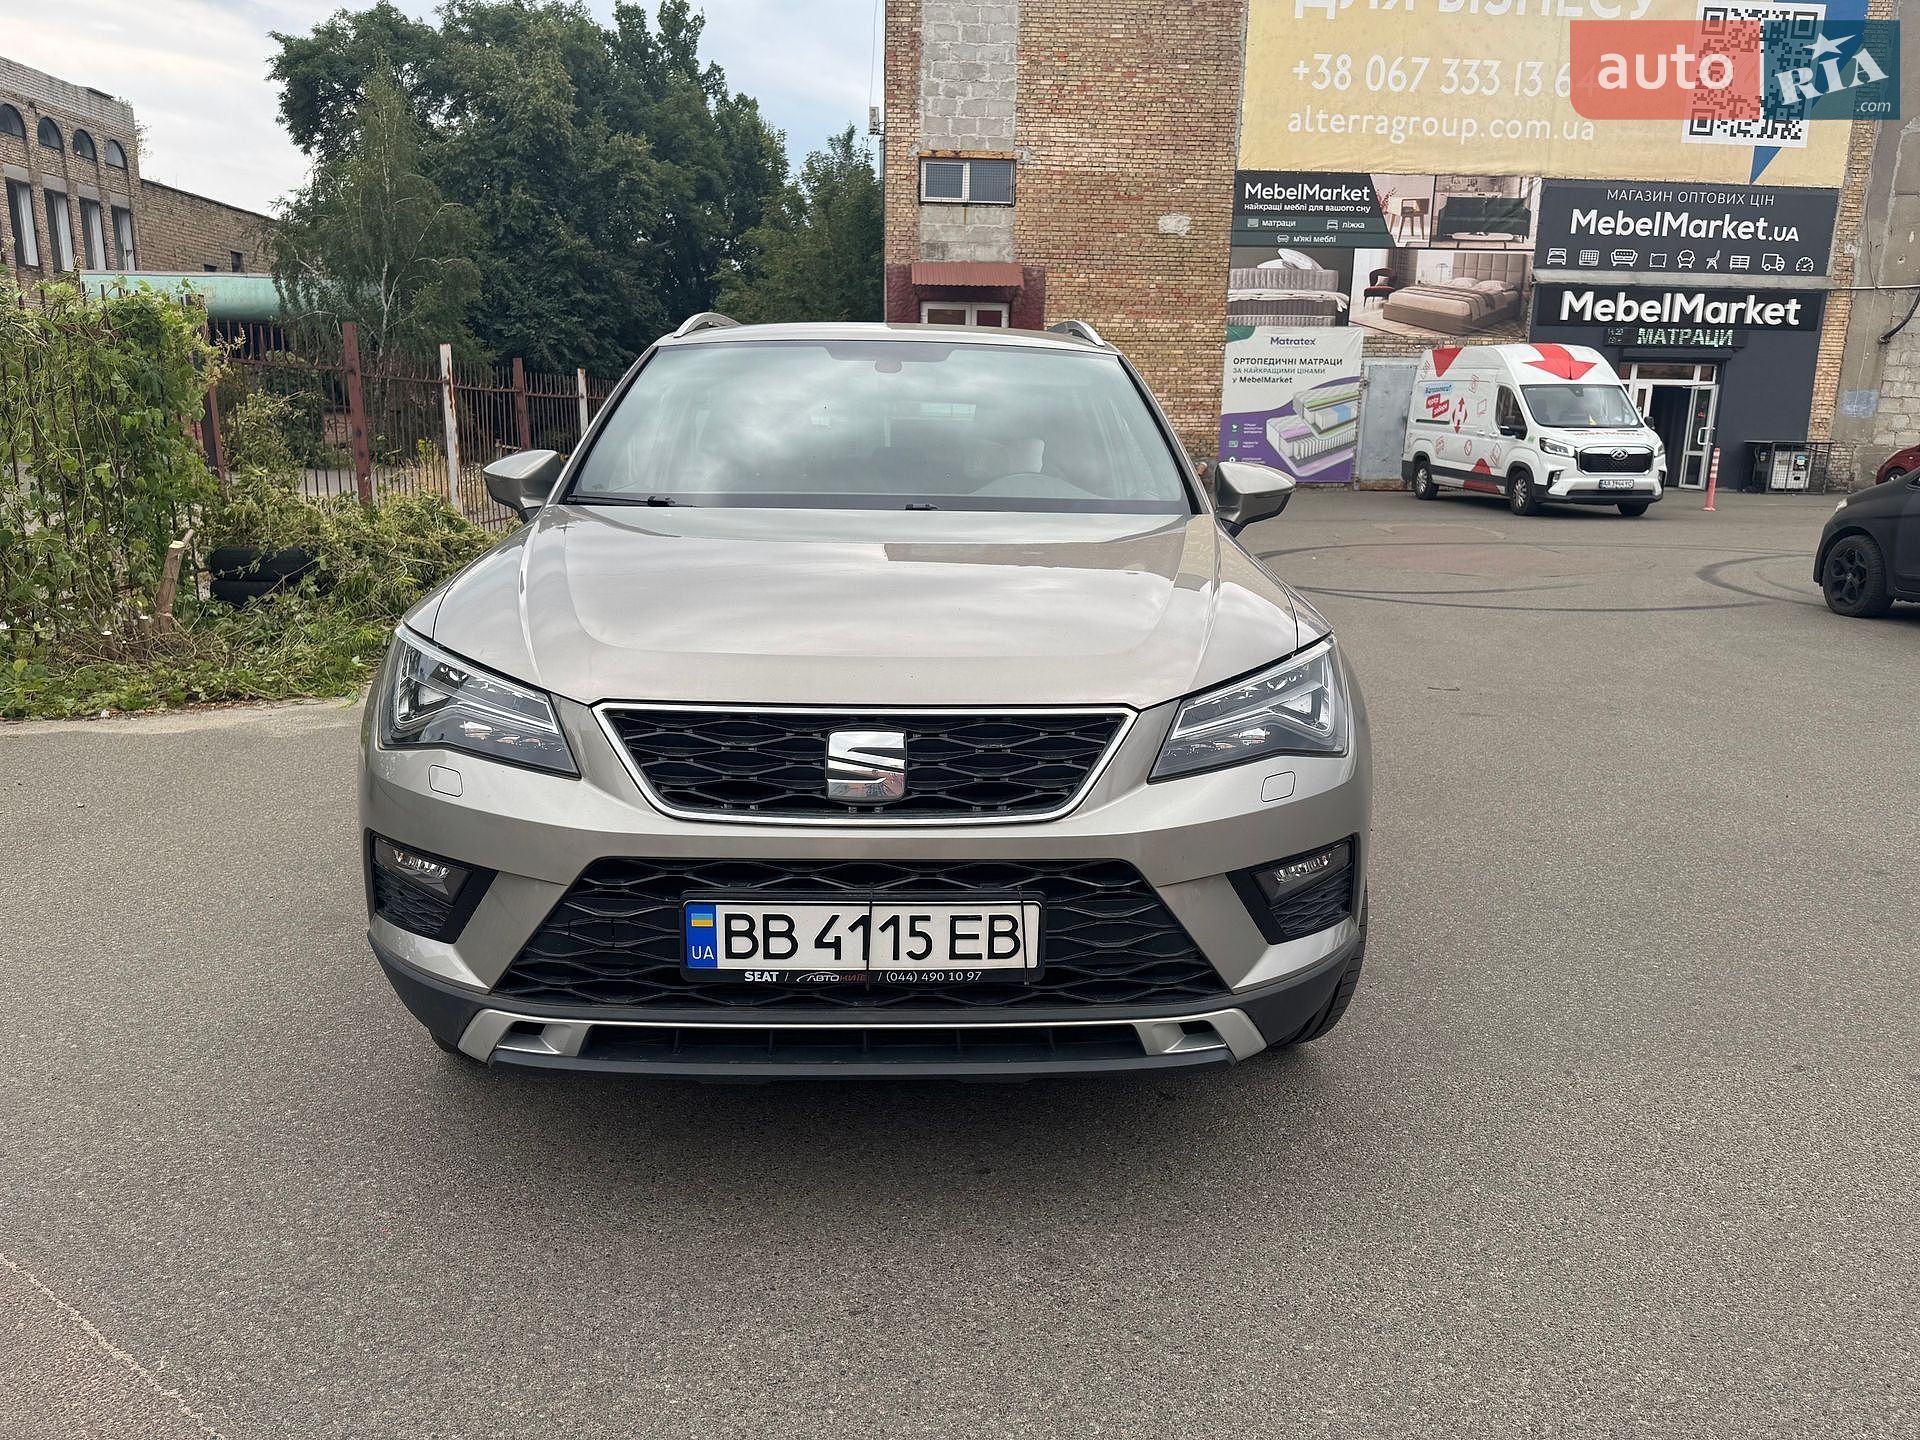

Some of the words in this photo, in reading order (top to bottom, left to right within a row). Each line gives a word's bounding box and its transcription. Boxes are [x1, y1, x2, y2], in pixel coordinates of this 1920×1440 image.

[1292, 53, 1352, 91] +38
[1365, 54, 1431, 92] 067
[1440, 57, 1501, 96] 333
[1514, 61, 1544, 97] 13
[1287, 104, 1594, 144] alterragroup.com.ua
[1245, 183, 1370, 201] MebelMarket
[1607, 189, 1673, 202] МАГАЗИН
[1677, 191, 1746, 205] ОПТОВИХ
[1750, 194, 1775, 207] ЦІН
[1244, 202, 1282, 211] найкращі
[1284, 203, 1307, 211] меблі
[1308, 204, 1323, 212] для
[1325, 204, 1354, 212] вашого
[1356, 205, 1371, 214] сну
[1261, 219, 1296, 228] матраци
[1342, 220, 1365, 229] ліжка
[1569, 208, 1799, 242] MebelMarket.UA
[1313, 235, 1336, 243] меблі
[1559, 290, 1801, 326] MebelMarket
[1270, 336, 1316, 345] Matratex
[1636, 327, 1734, 347] МАТРАЦИ
[1233, 357, 1297, 366] ОРТОПЕДИЧНІ
[1299, 358, 1343, 366] МАТРАЦИ
[1239, 376, 1293, 384] MebelMarket
[692, 946, 714, 960] UA
[724, 913, 799, 960] BB
[814, 914, 933, 961] 4115
[949, 914, 1021, 960] EB
[744, 971, 779, 982] SEAT
[886, 971, 918, 983] (044)
[921, 971, 945, 982] 490
[949, 971, 963, 982] 10
[966, 971, 982, 982] 97
